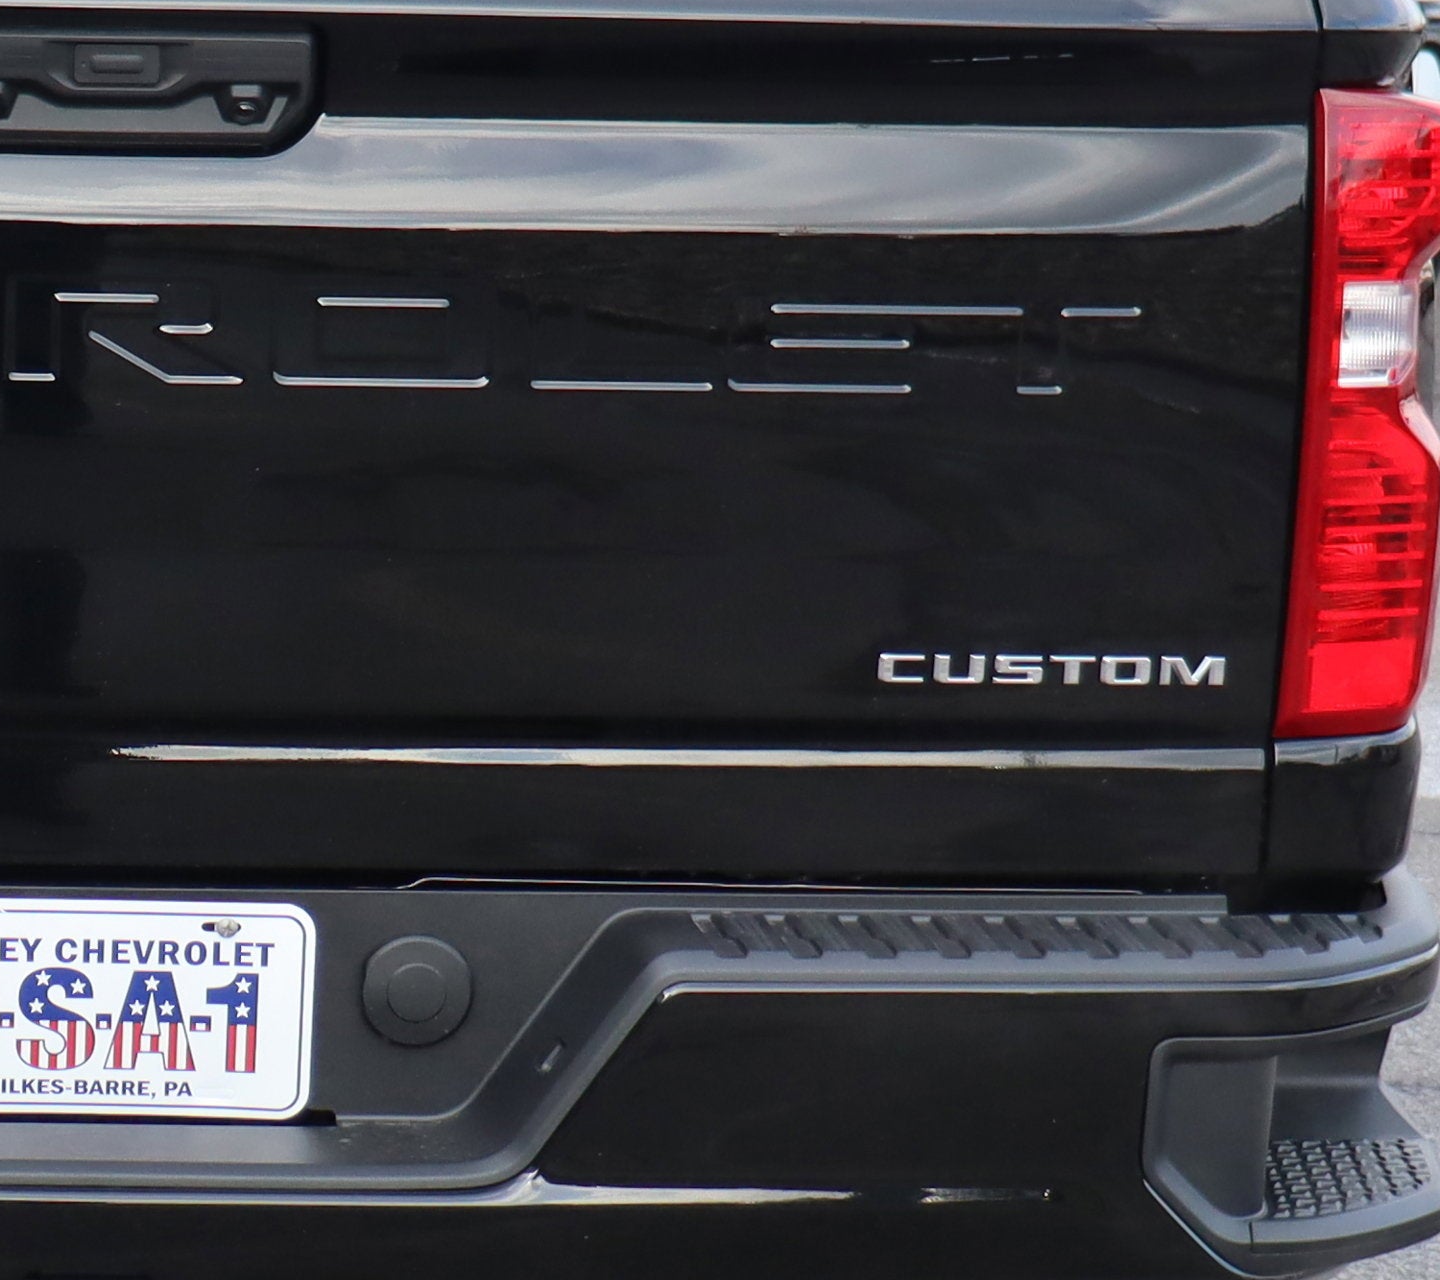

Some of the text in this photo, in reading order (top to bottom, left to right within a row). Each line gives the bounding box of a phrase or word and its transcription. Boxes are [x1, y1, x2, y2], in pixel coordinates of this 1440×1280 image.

[877, 652, 1226, 686] CUSTOM
[54, 937, 275, 968] CHEVROLET
[163, 1079, 193, 1098] PA
